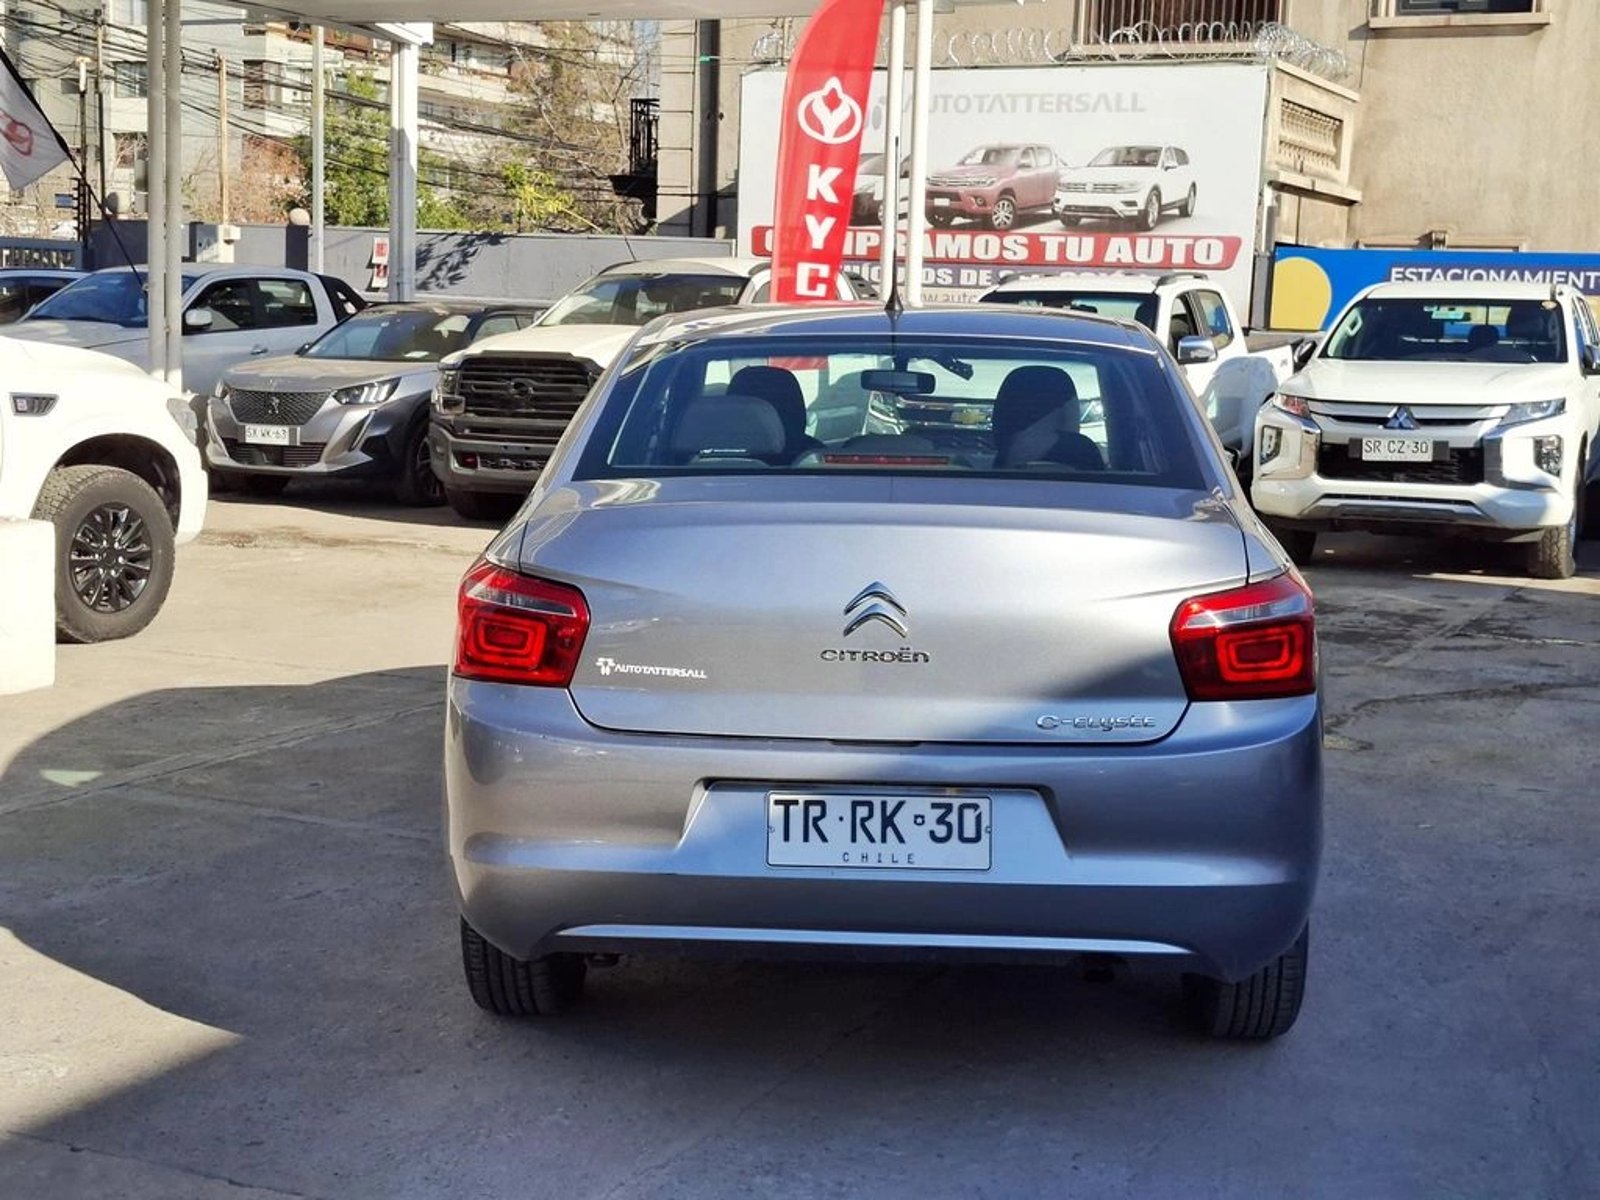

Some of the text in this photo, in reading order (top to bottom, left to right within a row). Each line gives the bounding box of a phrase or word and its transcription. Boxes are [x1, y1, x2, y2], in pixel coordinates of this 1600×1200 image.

[1040, 237, 1095, 262] TU
[1104, 238, 1225, 265] AUTO
[960, 268, 994, 287] DE
[614, 663, 708, 679] AUTOTATTERSALL
[842, 852, 915, 865] CHILE
